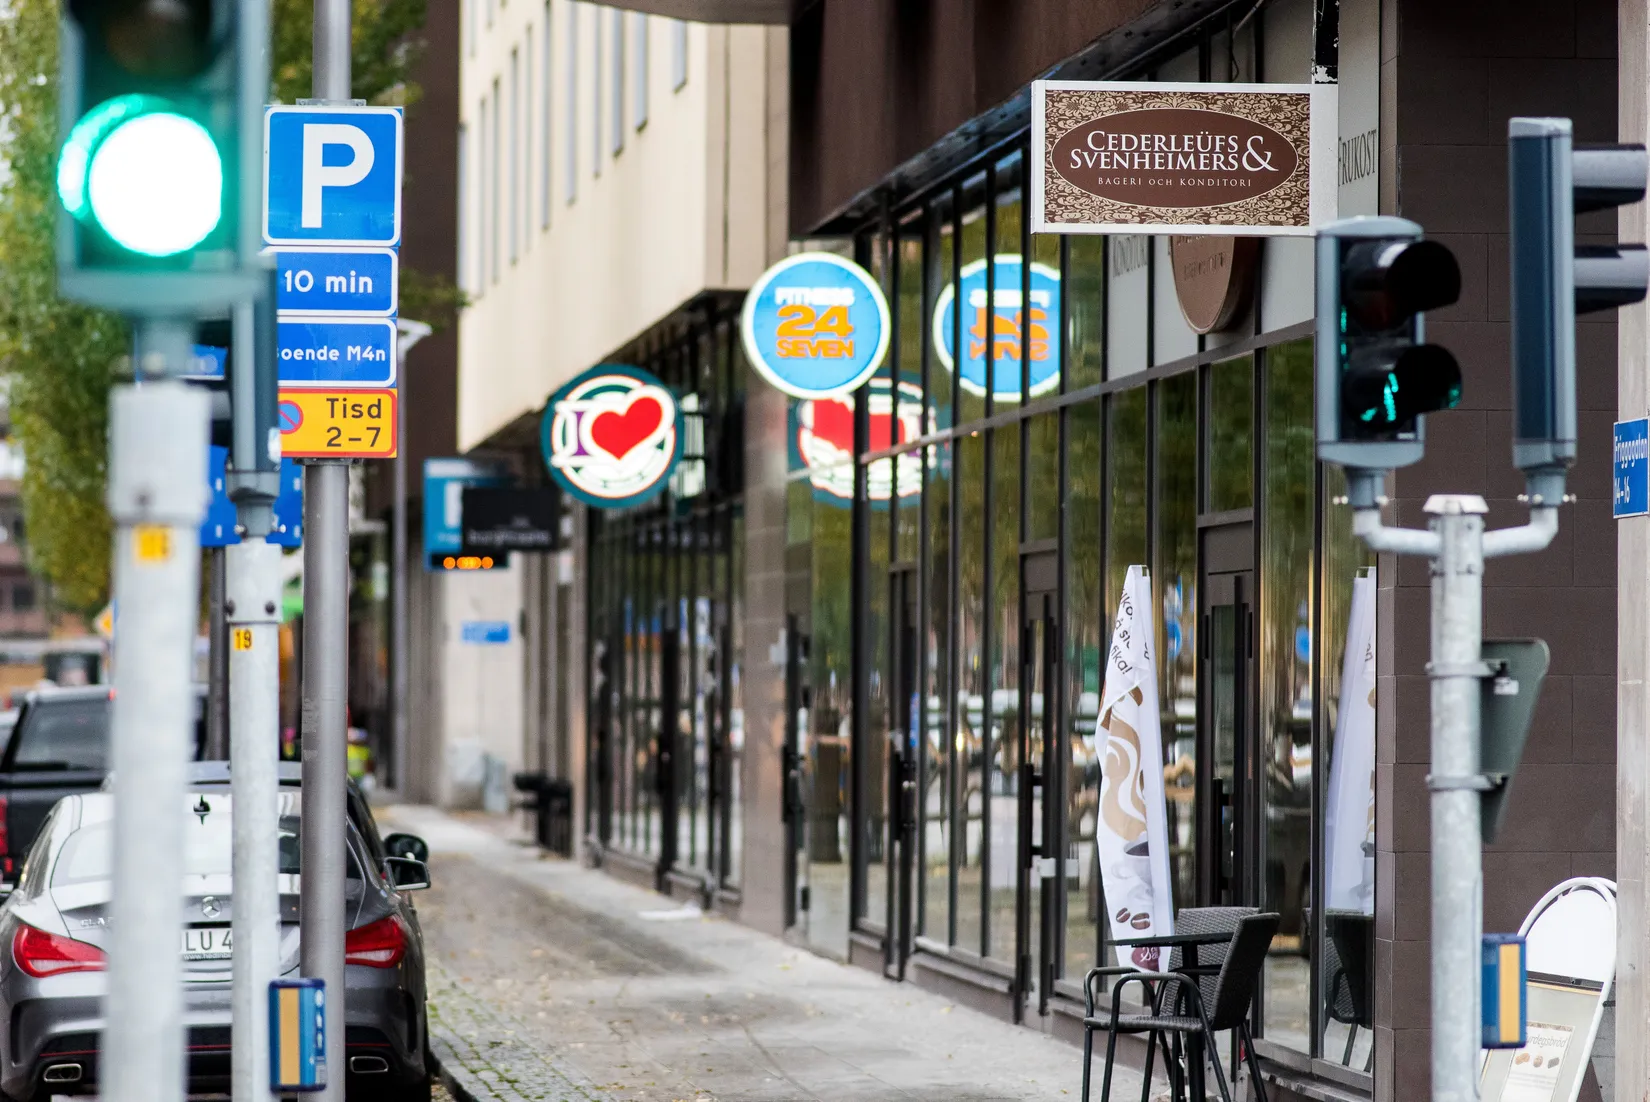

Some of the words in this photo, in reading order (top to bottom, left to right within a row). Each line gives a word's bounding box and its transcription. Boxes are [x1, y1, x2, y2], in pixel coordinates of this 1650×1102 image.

[1087, 130, 1239, 152] CEDERLEÜFS
[1070, 149, 1238, 171] SVENHEIMERS
[301, 122, 375, 229] P
[1098, 177, 1142, 186] BAGERI
[1180, 178, 1252, 188] KONDITORI
[284, 270, 314, 293] 10
[325, 270, 374, 294] min
[776, 306, 854, 337] 24
[277, 345, 340, 361] oende
[347, 345, 386, 361] M4n
[776, 339, 855, 359] SEVEN
[326, 398, 382, 419] Tisd
[326, 426, 381, 448] 2-7
[181, 931, 212, 951] LU
